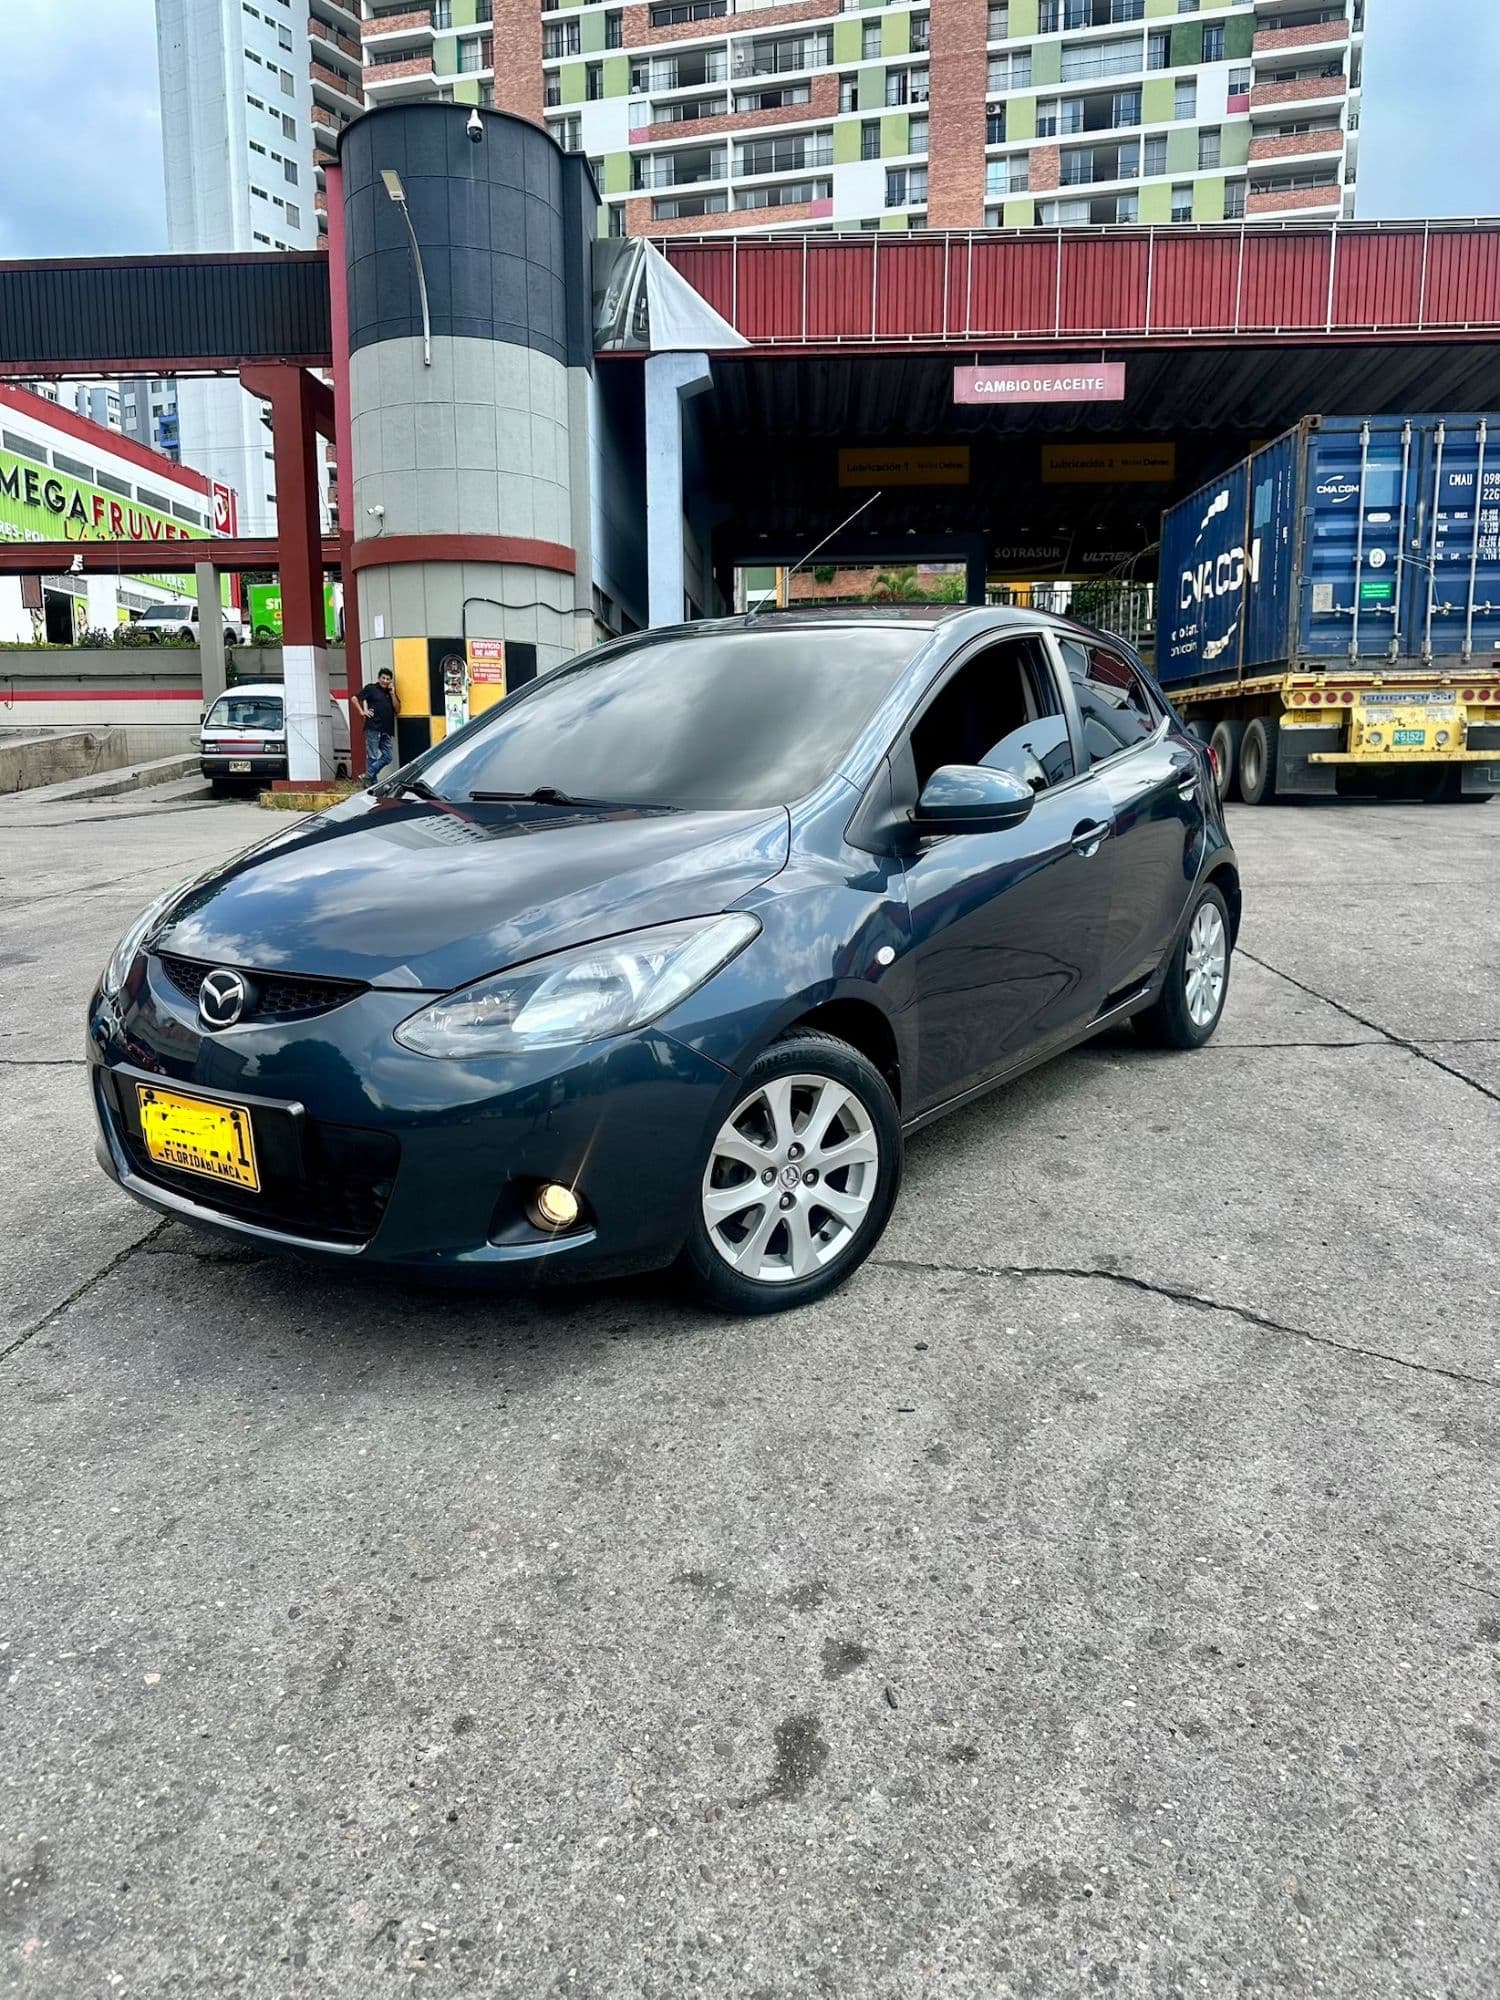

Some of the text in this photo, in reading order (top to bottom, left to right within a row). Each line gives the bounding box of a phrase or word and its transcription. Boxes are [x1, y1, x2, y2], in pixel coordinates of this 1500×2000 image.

[974, 378, 1104, 393] CAMBIO DE ACEITE
[1449, 474, 1473, 486] CMAU
[1316, 484, 1360, 494] CMA CGM
[993, 546, 1061, 559] SOTRASUR
